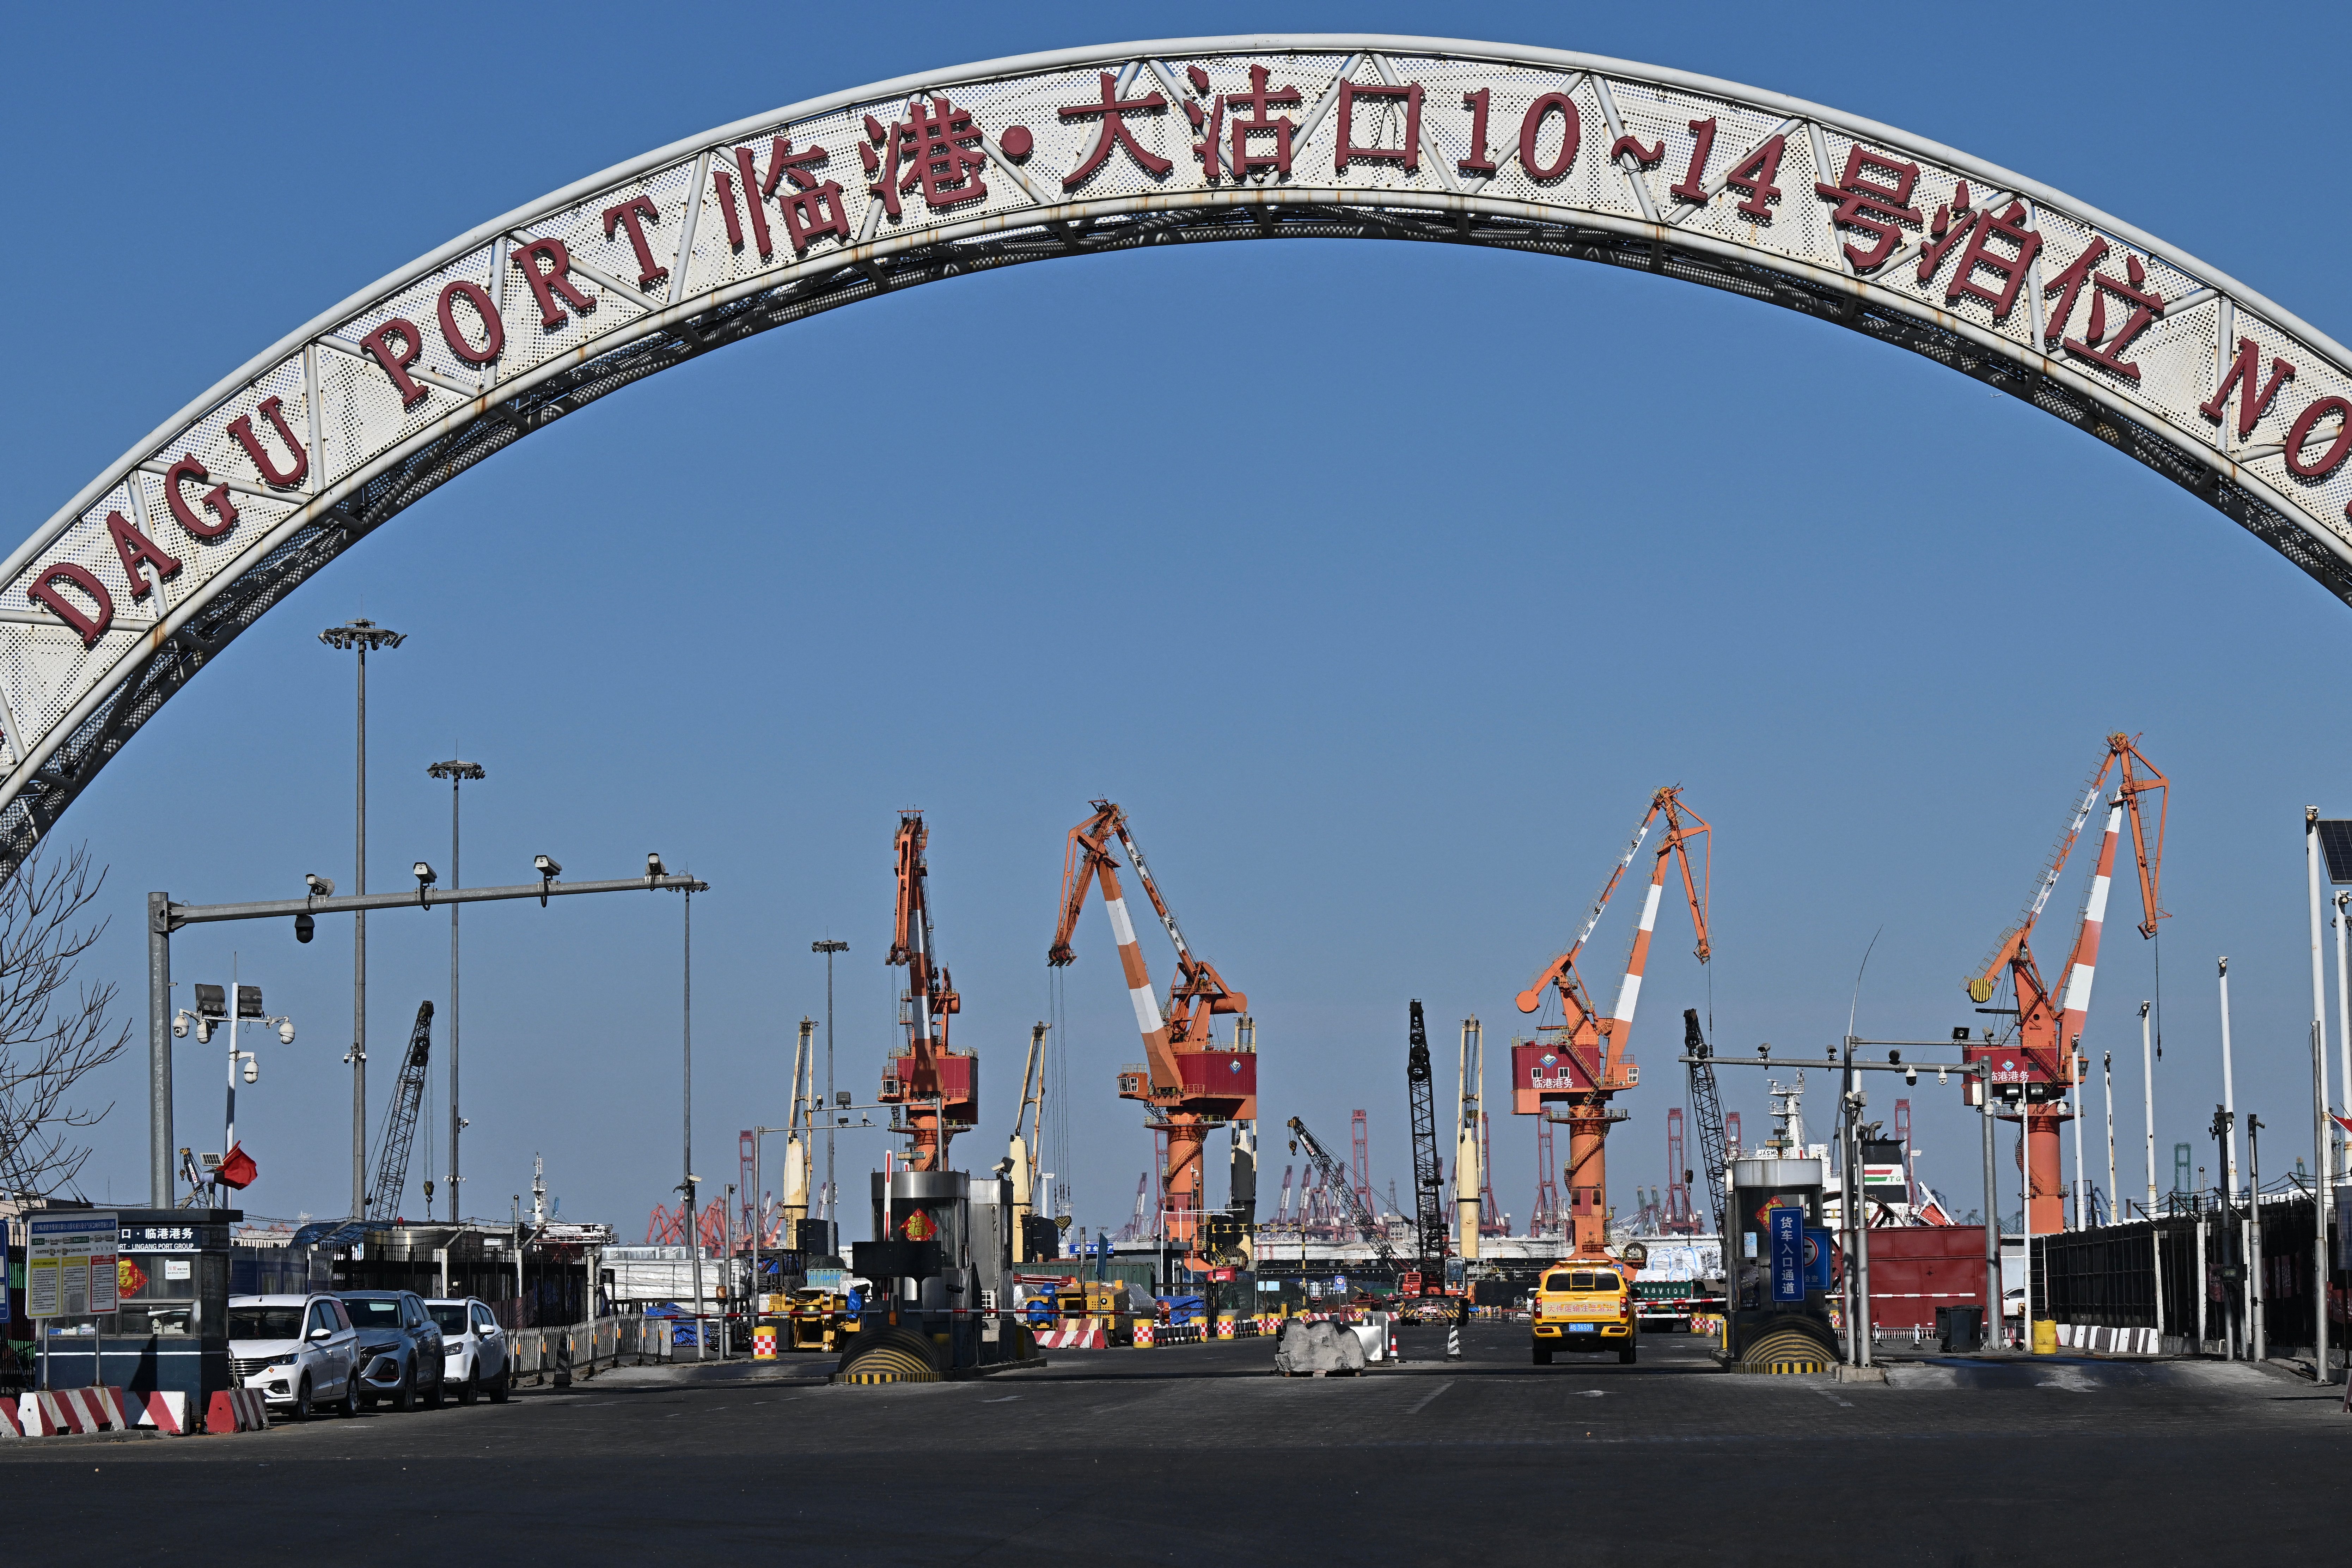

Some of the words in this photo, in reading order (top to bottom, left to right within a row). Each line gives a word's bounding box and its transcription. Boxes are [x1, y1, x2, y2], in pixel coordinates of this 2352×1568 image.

[27, 396, 306, 641] DAGU
[360, 196, 665, 403] PORT
[1533, 1078, 1574, 1088] 临港港务
[118, 1228, 193, 1239] 口·临港港务
[908, 1215, 928, 1237] 福
[1780, 1216, 1795, 1294] 货车入口通道
